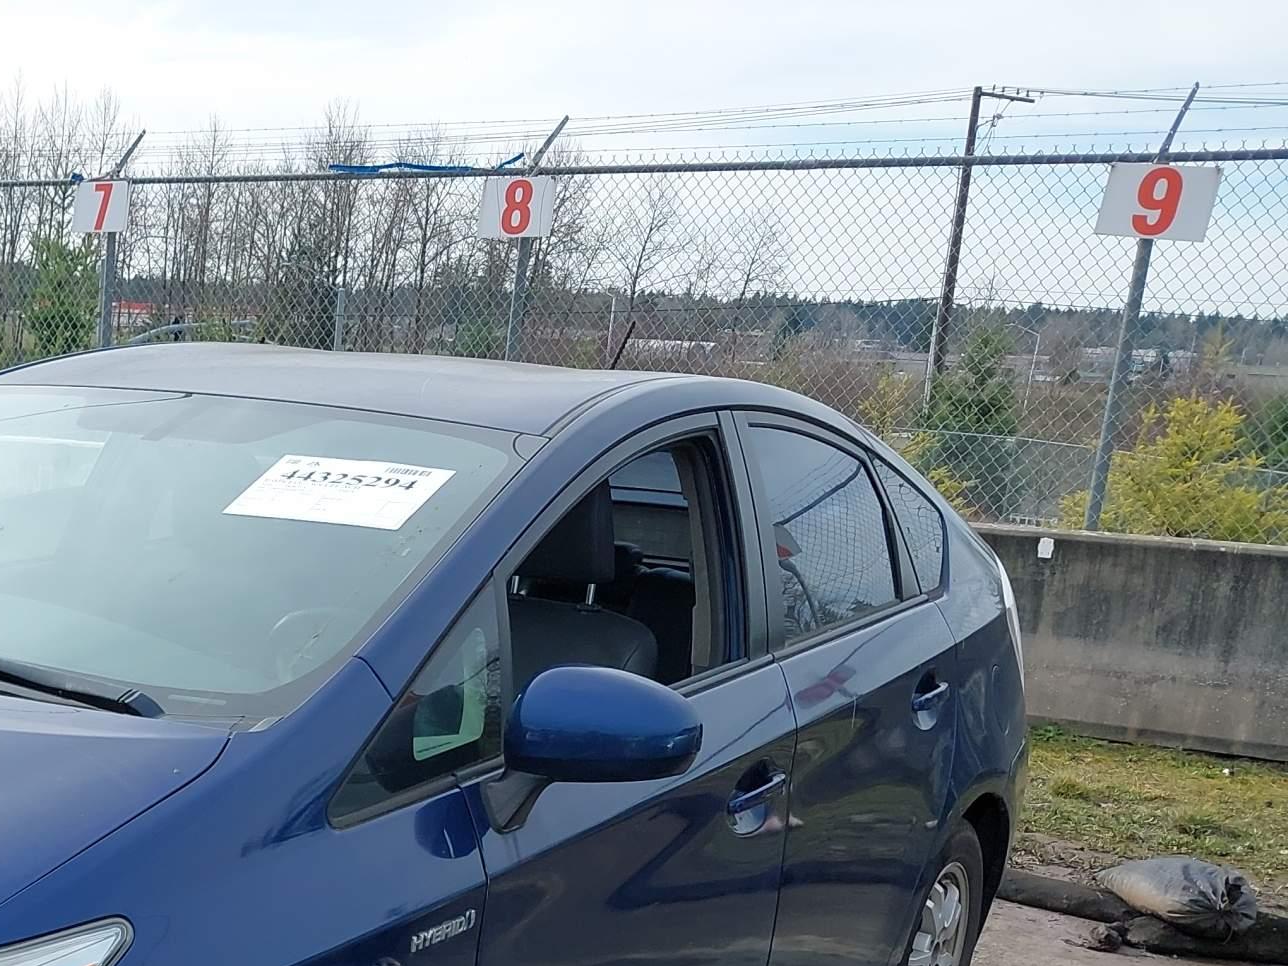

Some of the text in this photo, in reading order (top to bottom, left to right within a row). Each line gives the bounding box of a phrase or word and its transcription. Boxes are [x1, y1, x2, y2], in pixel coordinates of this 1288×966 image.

[93, 183, 114, 231] 7
[501, 178, 534, 235] 8
[1131, 166, 1183, 237] 9
[280, 468, 418, 491] 44325294
